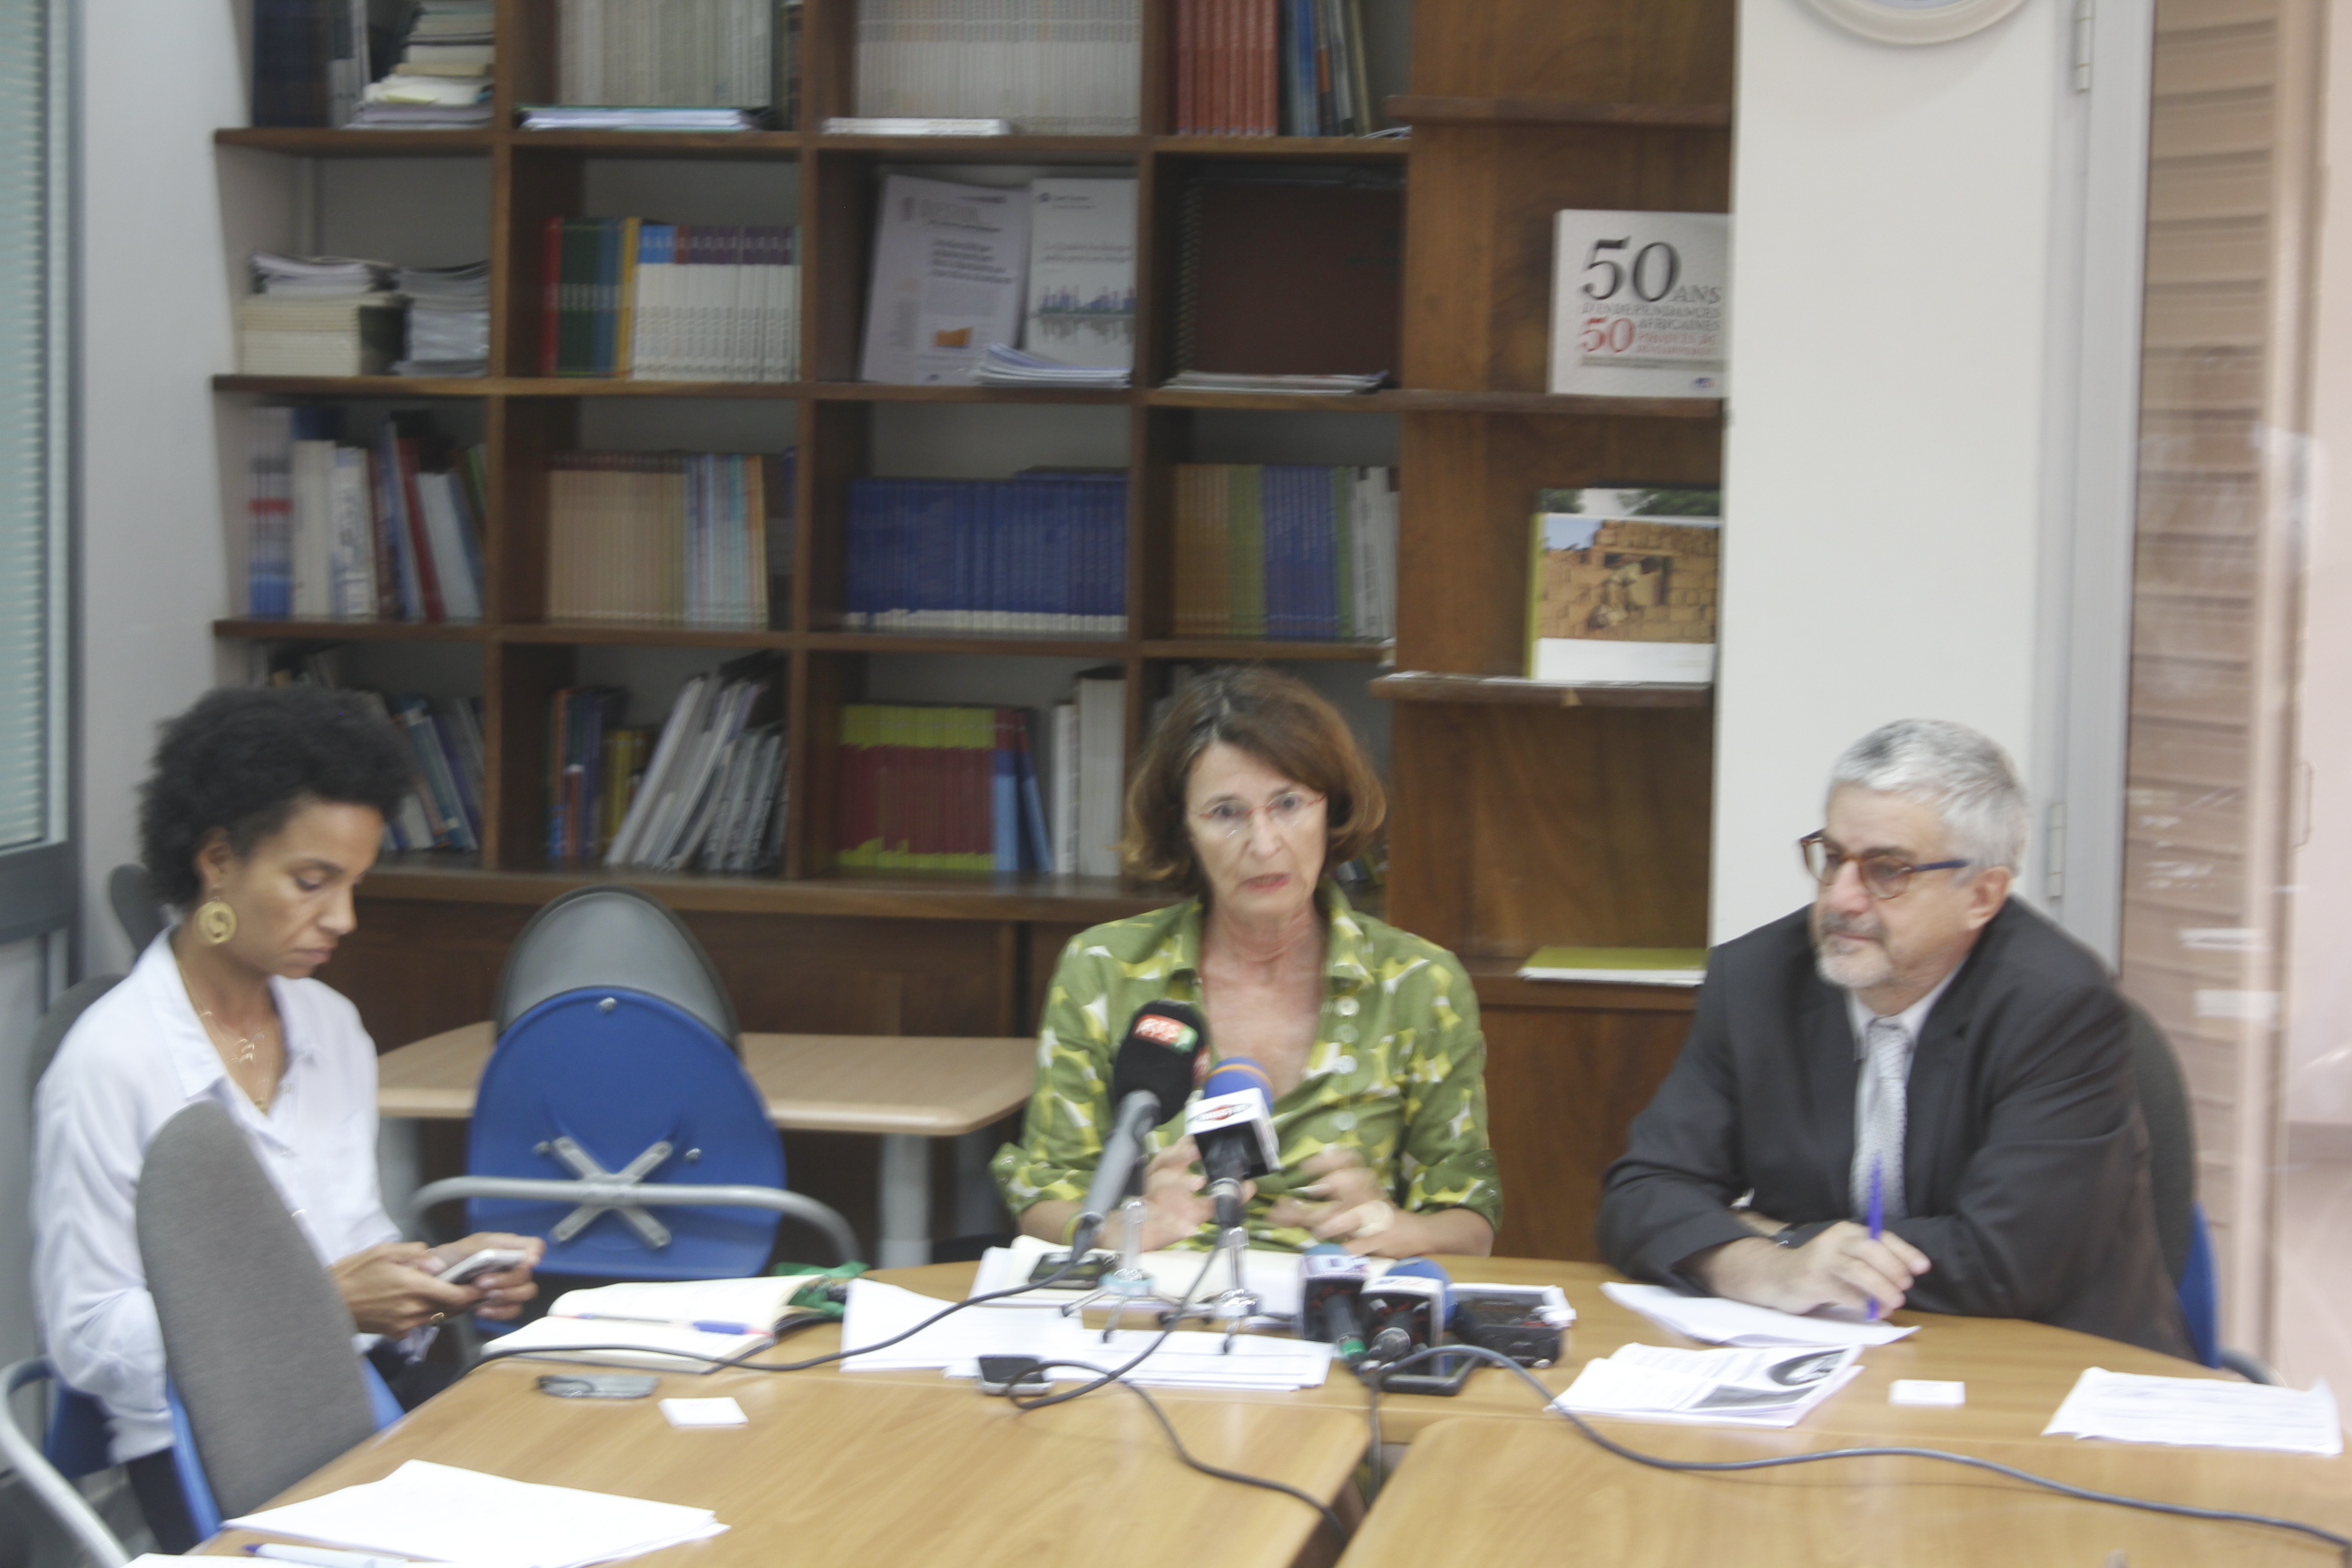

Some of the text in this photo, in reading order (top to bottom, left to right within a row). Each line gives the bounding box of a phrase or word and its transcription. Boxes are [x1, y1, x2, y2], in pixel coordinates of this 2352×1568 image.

[1581, 235, 1722, 304] 50 ANS
[1578, 317, 1636, 353] 50
